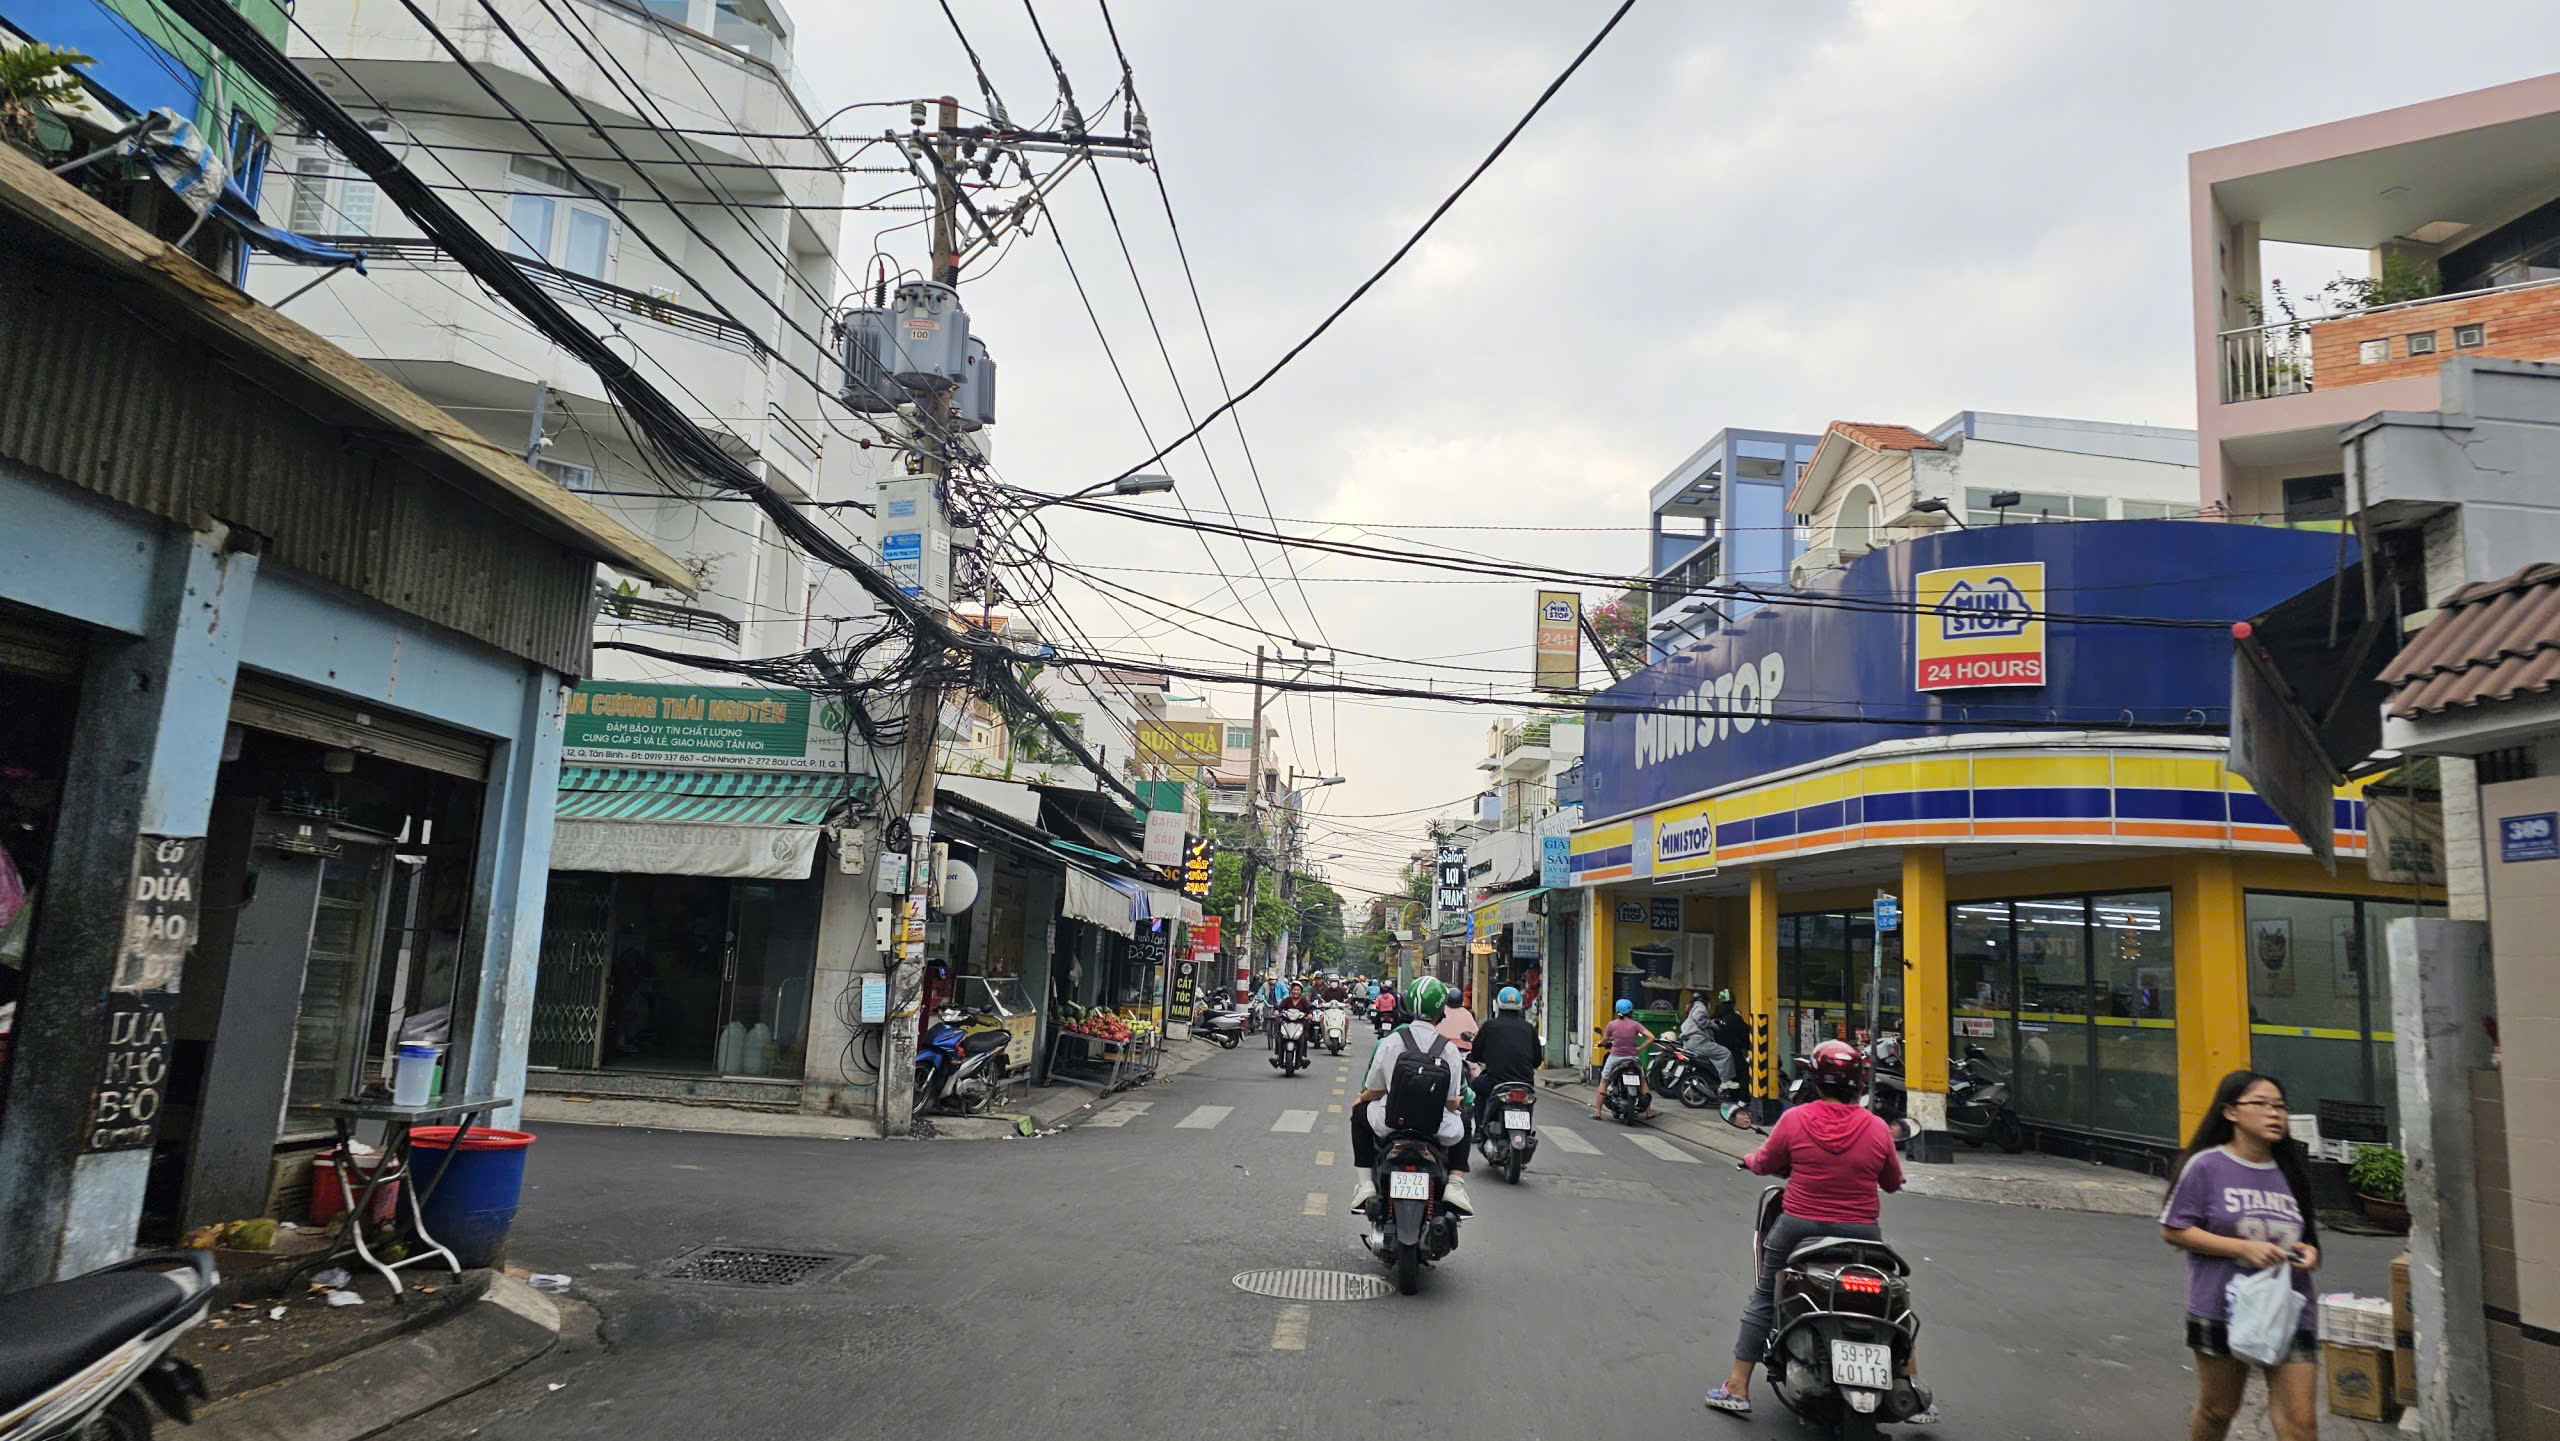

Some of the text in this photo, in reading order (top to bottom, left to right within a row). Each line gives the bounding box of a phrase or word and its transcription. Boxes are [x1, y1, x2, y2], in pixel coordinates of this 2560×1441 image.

[912, 331, 928, 339] 100
[1955, 593, 2009, 613] MINI
[1543, 632, 1575, 647] 24H
[1927, 660, 2041, 681] 24 HOURS
[662, 694, 705, 720] THÁI
[708, 697, 787, 724] NGUYÊN
[1635, 652, 1785, 770] MINISTOP
[606, 722, 627, 732] ĐẢM
[629, 723, 650, 733] BẢO
[650, 725, 664, 734] UY
[682, 724, 709, 736] CHẤT
[709, 727, 743, 738] LƯỢNG
[1140, 725, 1218, 753] BÚN CHẢ
[582, 733, 610, 743] CUNG
[611, 732, 632, 744] CẤP
[643, 735, 655, 745] VÀ
[671, 738, 695, 747] GIAO
[696, 738, 724, 748] HÀNG
[726, 739, 747, 751] TẬN
[748, 740, 764, 750] NƠI
[644, 752, 663, 761] 0919
[663, 753, 679, 762] 337
[679, 753, 695, 762] 867
[717, 755, 746, 764] Nhánh
[756, 757, 770, 765] 272
[809, 759, 818, 768] P.
[828, 760, 838, 769] Q.
[1662, 827, 1708, 855] MINISTOP
[1442, 850, 1464, 863] Salon
[1446, 867, 1459, 888] LỢI
[1441, 890, 1463, 909] PHẠM
[1652, 916, 1678, 928] 24H
[1145, 945, 1167, 965] 25
[1175, 990, 1191, 1003] TÓC
[1172, 1004, 1190, 1017] NAM
[1393, 1186, 1425, 1199] 177.41
[1841, 1344, 1882, 1366] 59-P2
[1837, 1363, 1888, 1386] 401.13
